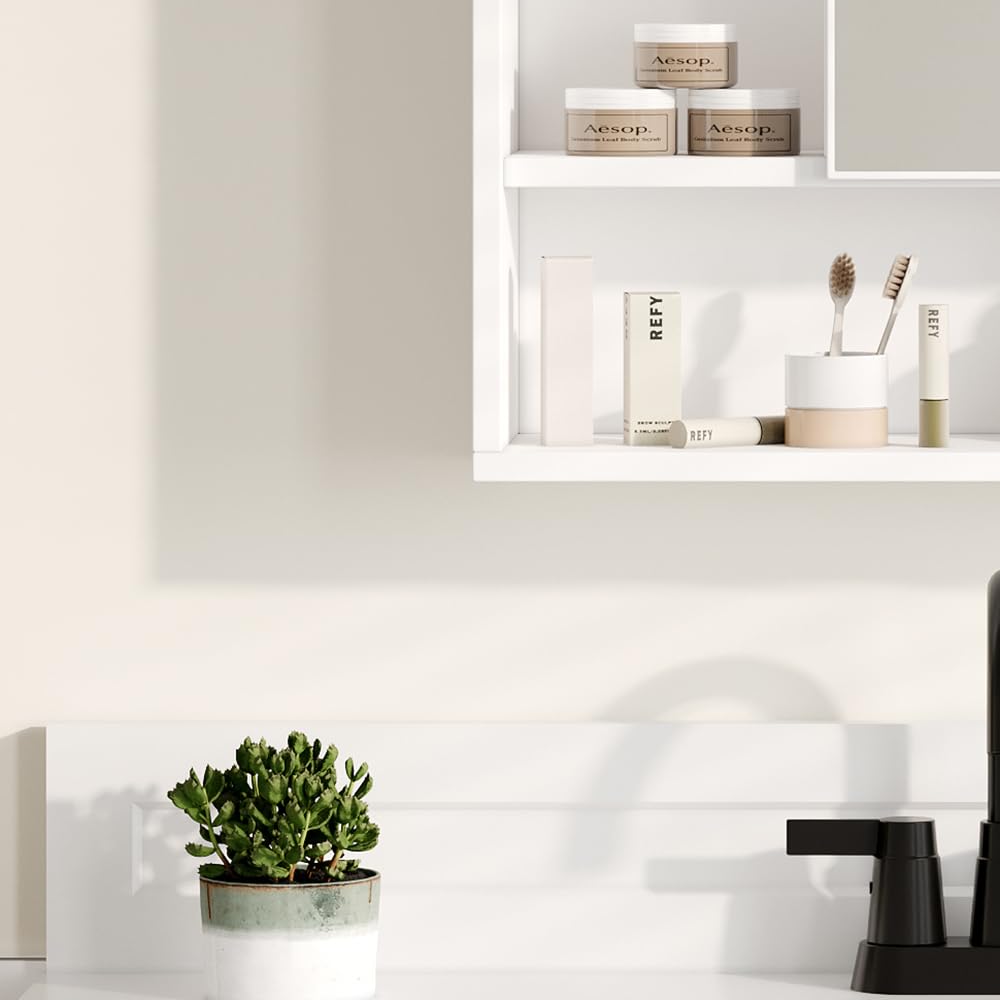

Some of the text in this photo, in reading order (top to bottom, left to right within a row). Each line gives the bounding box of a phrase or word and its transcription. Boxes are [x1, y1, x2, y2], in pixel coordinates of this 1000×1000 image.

[649, 296, 663, 341] REFY
[927, 309, 939, 338] REFY
[690, 430, 713, 441] REFY
